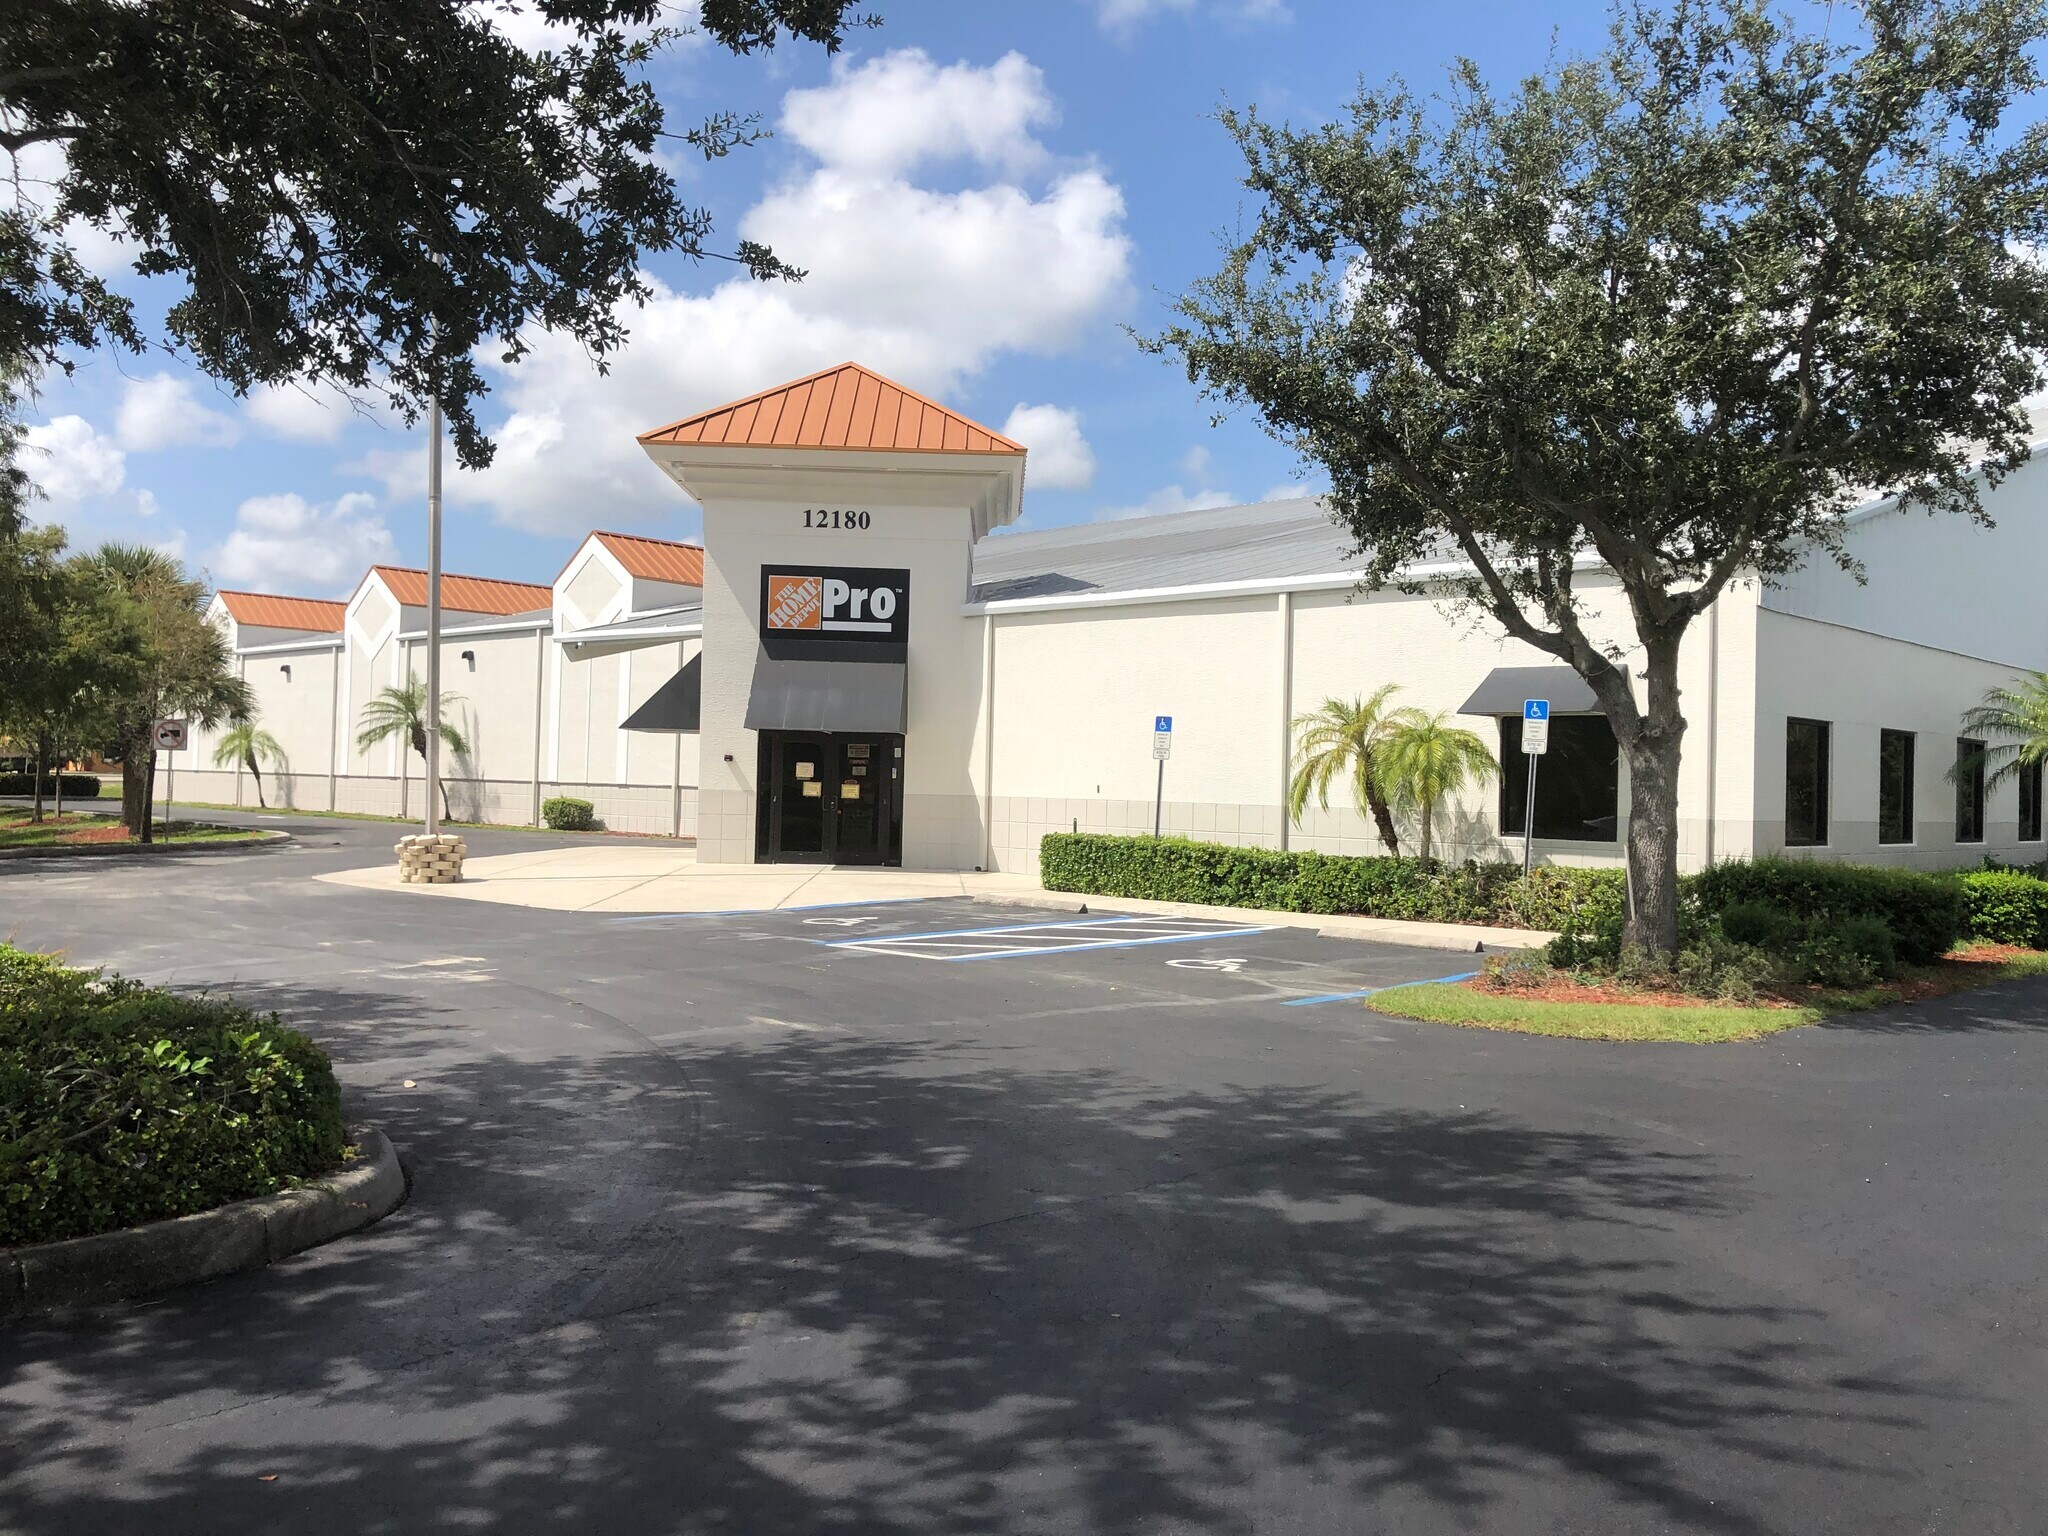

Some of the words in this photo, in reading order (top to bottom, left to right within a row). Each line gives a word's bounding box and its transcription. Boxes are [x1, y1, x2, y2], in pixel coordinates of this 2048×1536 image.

[803, 509, 871, 530] 12180
[769, 578, 820, 628] HOME
[774, 582, 797, 602] THE
[822, 578, 896, 619] Pro
[789, 596, 820, 628] DEPOT
